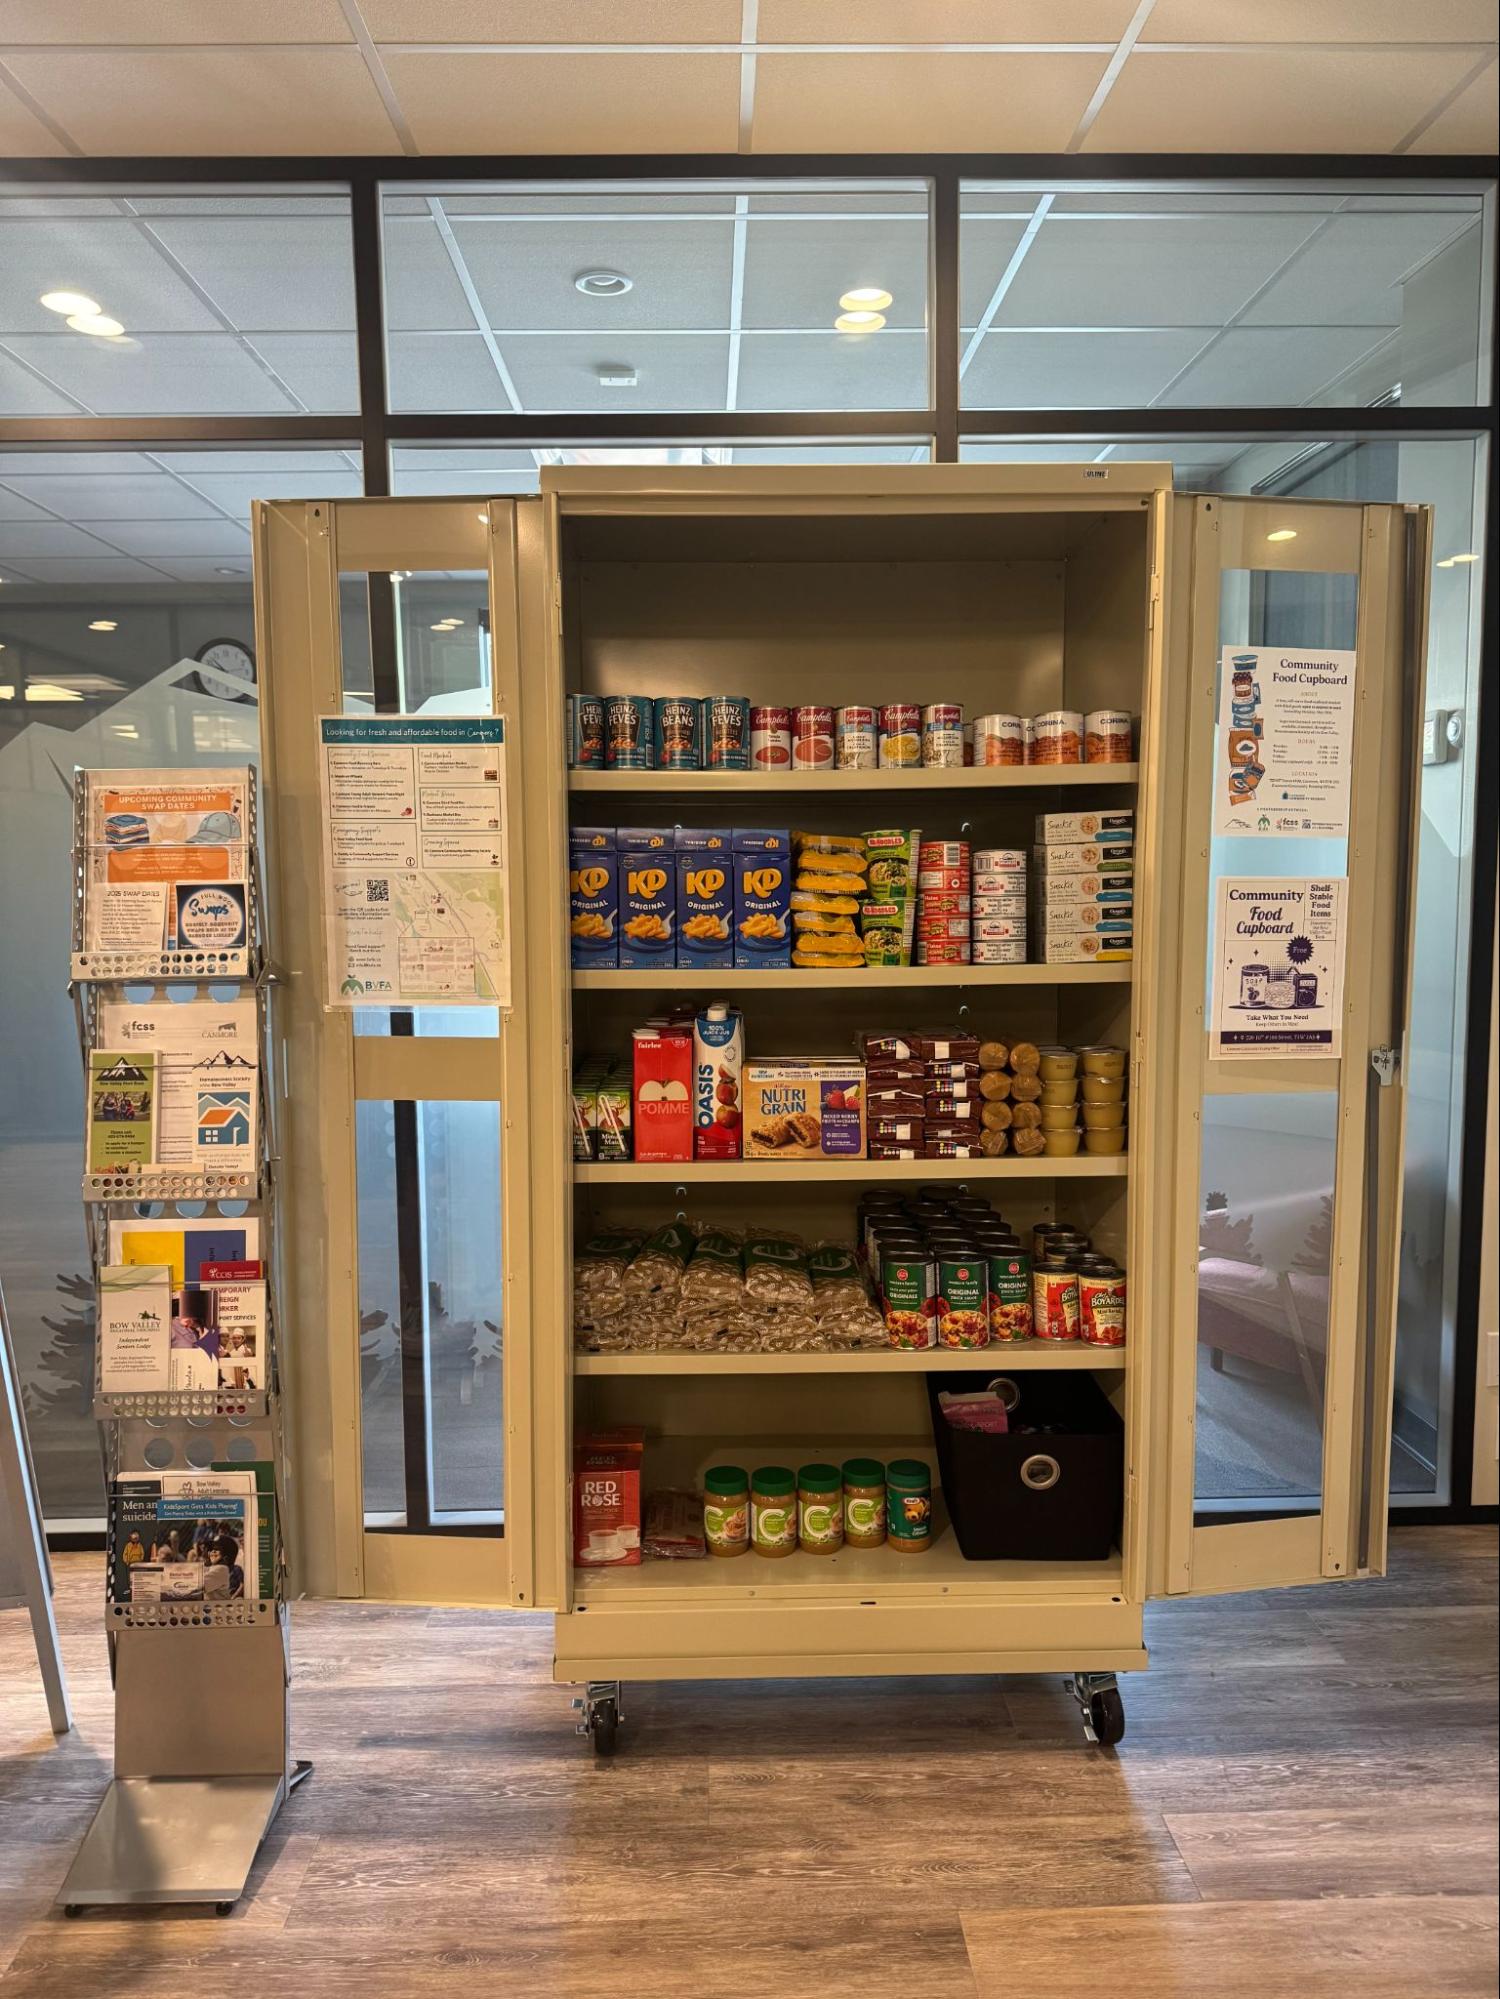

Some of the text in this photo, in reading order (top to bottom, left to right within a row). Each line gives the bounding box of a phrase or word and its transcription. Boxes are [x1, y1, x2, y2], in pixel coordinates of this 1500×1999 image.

[1280, 658, 1339, 673] Community
[1273, 672, 1348, 686] Food Cupboard
[610, 705, 635, 714] HEINZ
[665, 706, 691, 715] HEINZ
[714, 706, 740, 715] HEINZ
[608, 714, 637, 726] FEVES
[662, 715, 694, 727] BEANS
[712, 715, 742, 726] FEVES
[326, 728, 354, 738] Looking
[355, 728, 366, 736] for
[368, 728, 387, 736] fresh
[389, 728, 401, 736] and
[401, 728, 439, 736] affordable
[441, 728, 457, 736] food
[119, 794, 217, 804] UPCOMING COMMUNITY
[627, 868, 668, 899] KD
[685, 868, 725, 899] KD
[742, 867, 782, 898] KD
[1310, 884, 1333, 892] Shelf-
[1229, 889, 1304, 903] Community
[571, 899, 609, 909] ORIGINAL
[629, 901, 667, 910] ORIGINAL
[688, 901, 725, 910] ORIGINAL
[745, 900, 782, 910] ORIGINAL
[1249, 906, 1283, 920] Food
[1236, 920, 1294, 937] Cupboard
[365, 981, 392, 990] BVFA
[132, 1021, 155, 1031] fcss
[699, 1064, 713, 1129] OASIS
[761, 1089, 806, 1104] NUTRI
[638, 1102, 690, 1115] POMME
[761, 1101, 806, 1115] GRAIN
[947, 1288, 979, 1296] ORIGINAL
[585, 1480, 617, 1494] RED
[123, 1501, 145, 1510] Men
[122, 1511, 157, 1521] suicide
